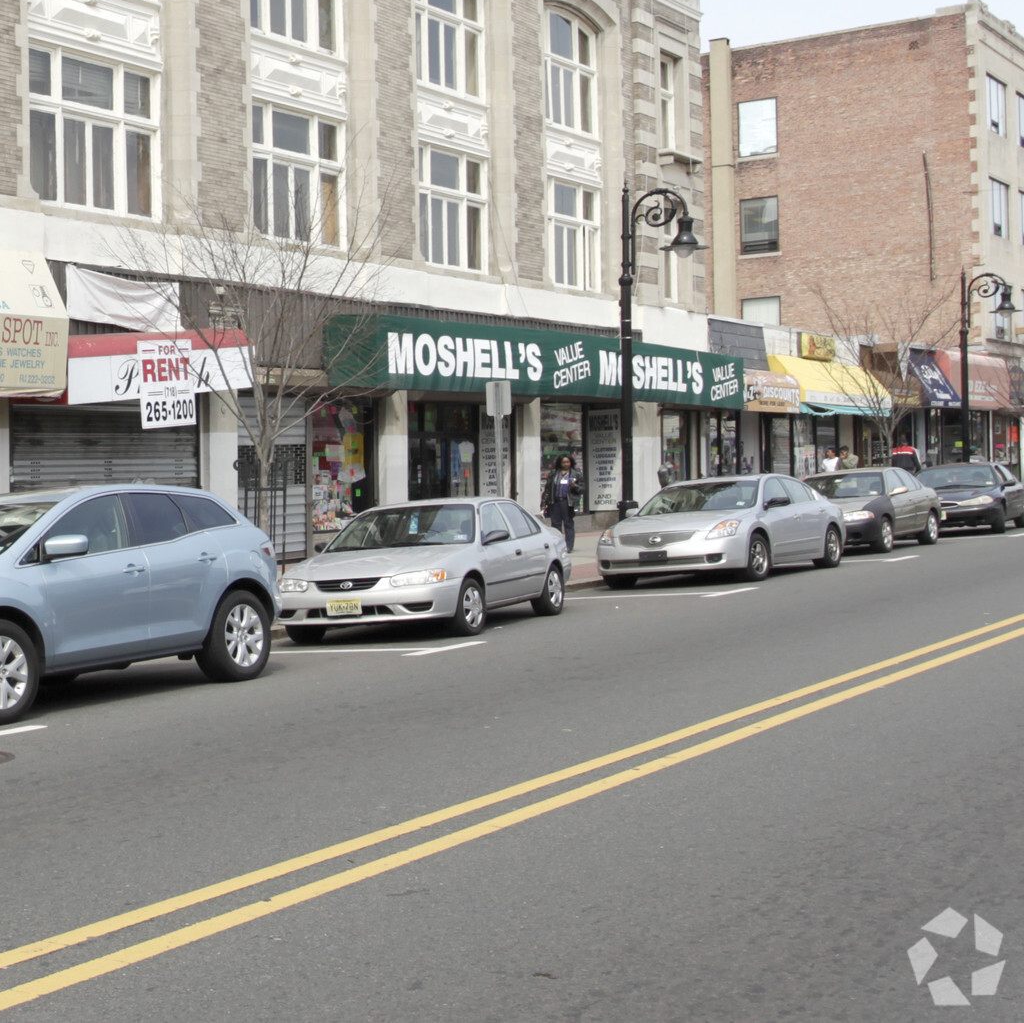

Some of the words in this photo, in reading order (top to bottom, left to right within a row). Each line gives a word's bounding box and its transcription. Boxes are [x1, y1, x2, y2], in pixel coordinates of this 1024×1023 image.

[1, 316, 43, 345] SPOT
[6, 347, 42, 358] WATCHES
[158, 345, 175, 356] FOR
[387, 331, 543, 382] MOSHELL'S
[554, 341, 585, 367] VALUE
[9, 359, 45, 369] JEWELRY
[142, 357, 190, 383] RENT
[553, 359, 591, 389] CENTER
[712, 362, 736, 383] VALUE
[710, 378, 739, 401] CENTER
[146, 399, 194, 422] 265-1200
